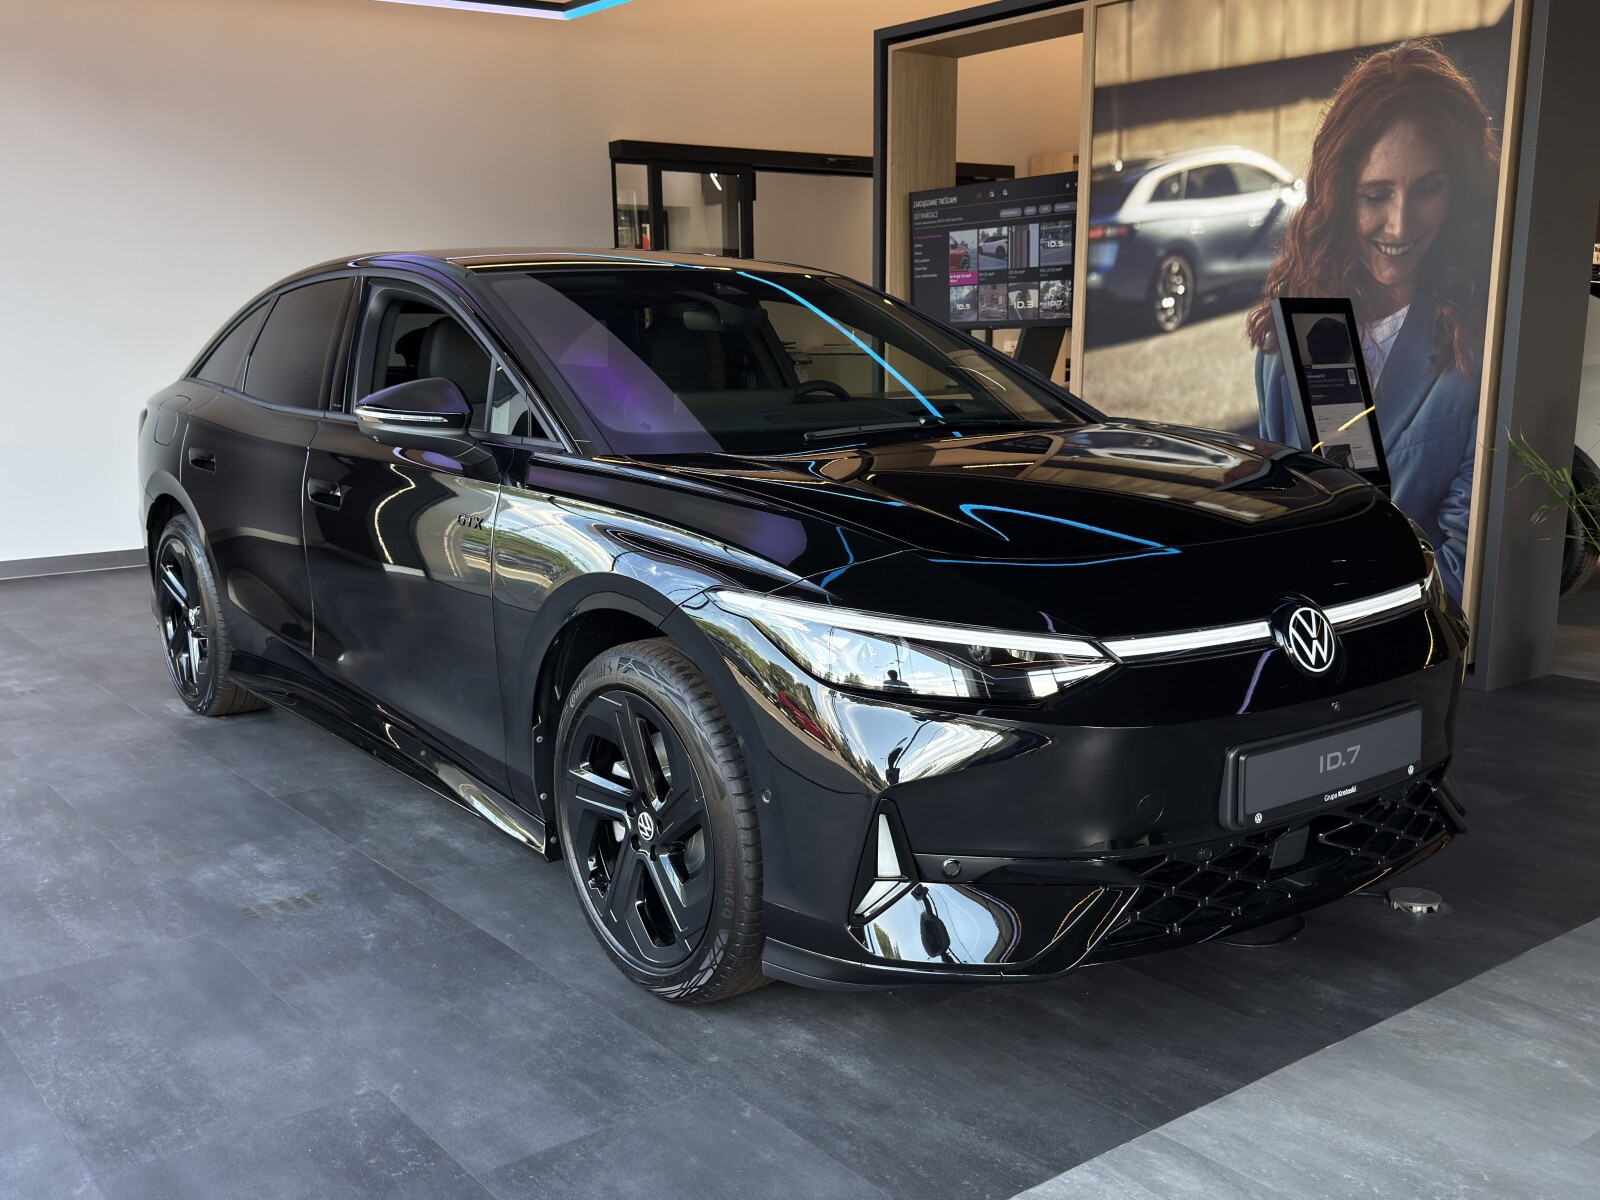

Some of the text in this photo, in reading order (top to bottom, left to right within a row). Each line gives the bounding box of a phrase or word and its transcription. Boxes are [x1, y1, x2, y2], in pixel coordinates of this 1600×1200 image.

[1047, 240, 1064, 248] ID.5
[1013, 300, 1034, 309] ID.3
[457, 513, 484, 530] GTX
[1319, 744, 1361, 774] ID.7
[1323, 785, 1357, 802] Grupa Krotoski
